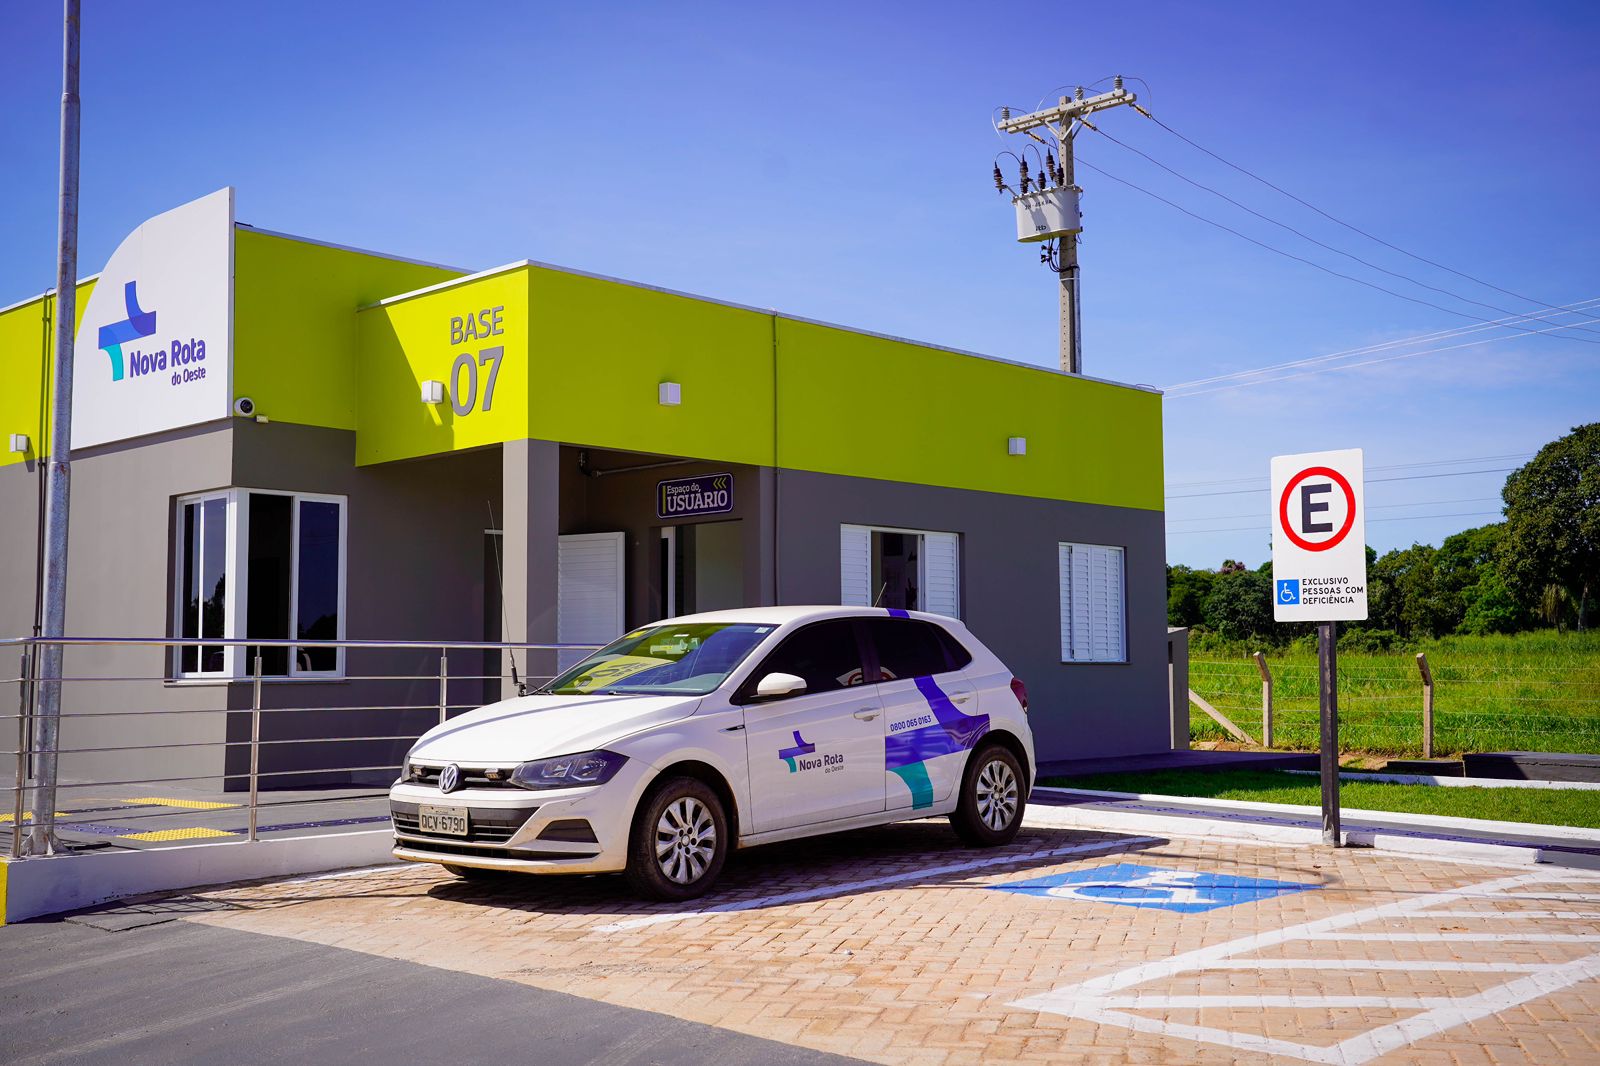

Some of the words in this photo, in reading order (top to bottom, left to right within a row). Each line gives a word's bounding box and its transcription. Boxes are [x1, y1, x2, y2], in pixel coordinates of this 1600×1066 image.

[450, 305, 505, 345] BASE
[129, 350, 167, 378] Nova
[170, 338, 206, 367] Rota
[171, 372, 182, 386] do
[183, 366, 206, 383] Oeste
[449, 346, 505, 417] 07
[666, 485, 691, 496] Espaço
[691, 482, 700, 492] do
[666, 487, 728, 512] USUÁRIO
[1301, 483, 1333, 534] E
[1302, 577, 1349, 586] EXCLUSIVO
[1302, 587, 1342, 595] PESSOAS
[1345, 586, 1364, 594] COM
[1302, 595, 1355, 605] DEFICIÊNCIA
[890, 721, 906, 732] 0800
[906, 718, 918, 728] 065
[918, 714, 932, 725] 0163
[799, 758, 822, 771] Nova
[824, 753, 844, 766] Rota
